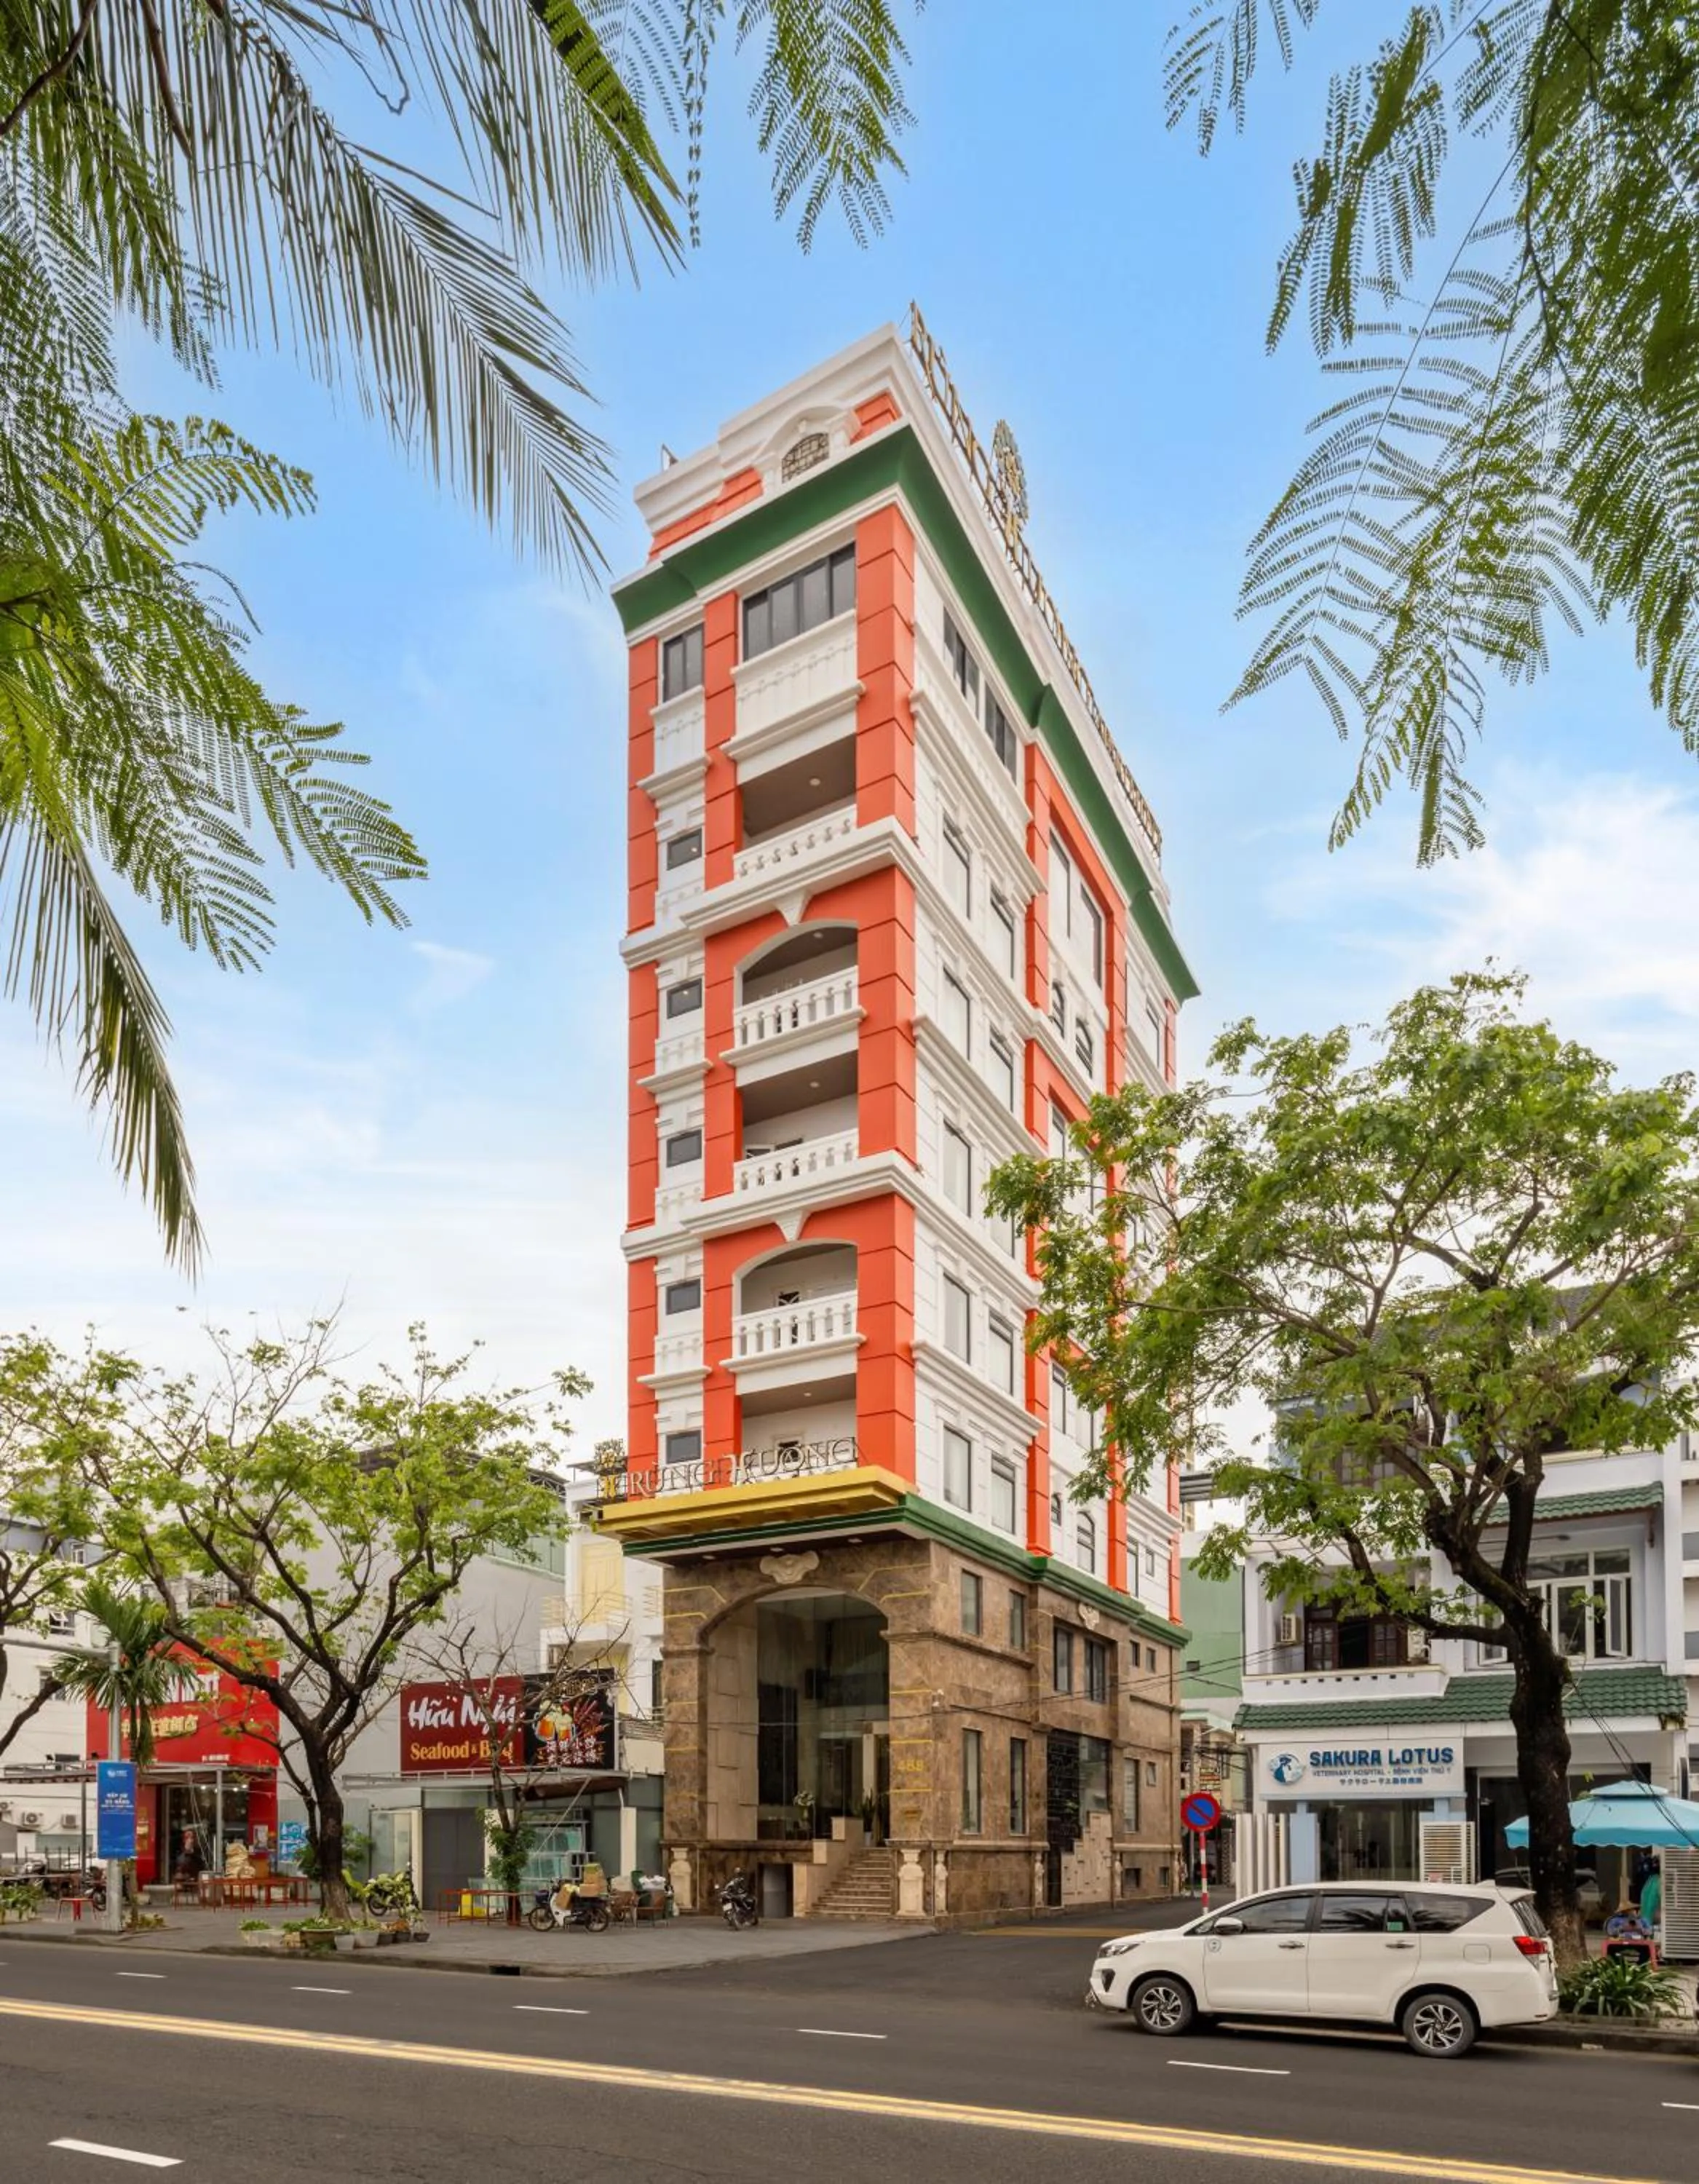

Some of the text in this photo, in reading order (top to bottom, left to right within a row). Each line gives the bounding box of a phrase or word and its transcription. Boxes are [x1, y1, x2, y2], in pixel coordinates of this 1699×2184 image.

[408, 1696, 455, 1730] Hữu
[410, 1740, 470, 1760] Seafood
[480, 1738, 514, 1762] BQ
[1310, 1747, 1454, 1767] SAKURA LOTUS
